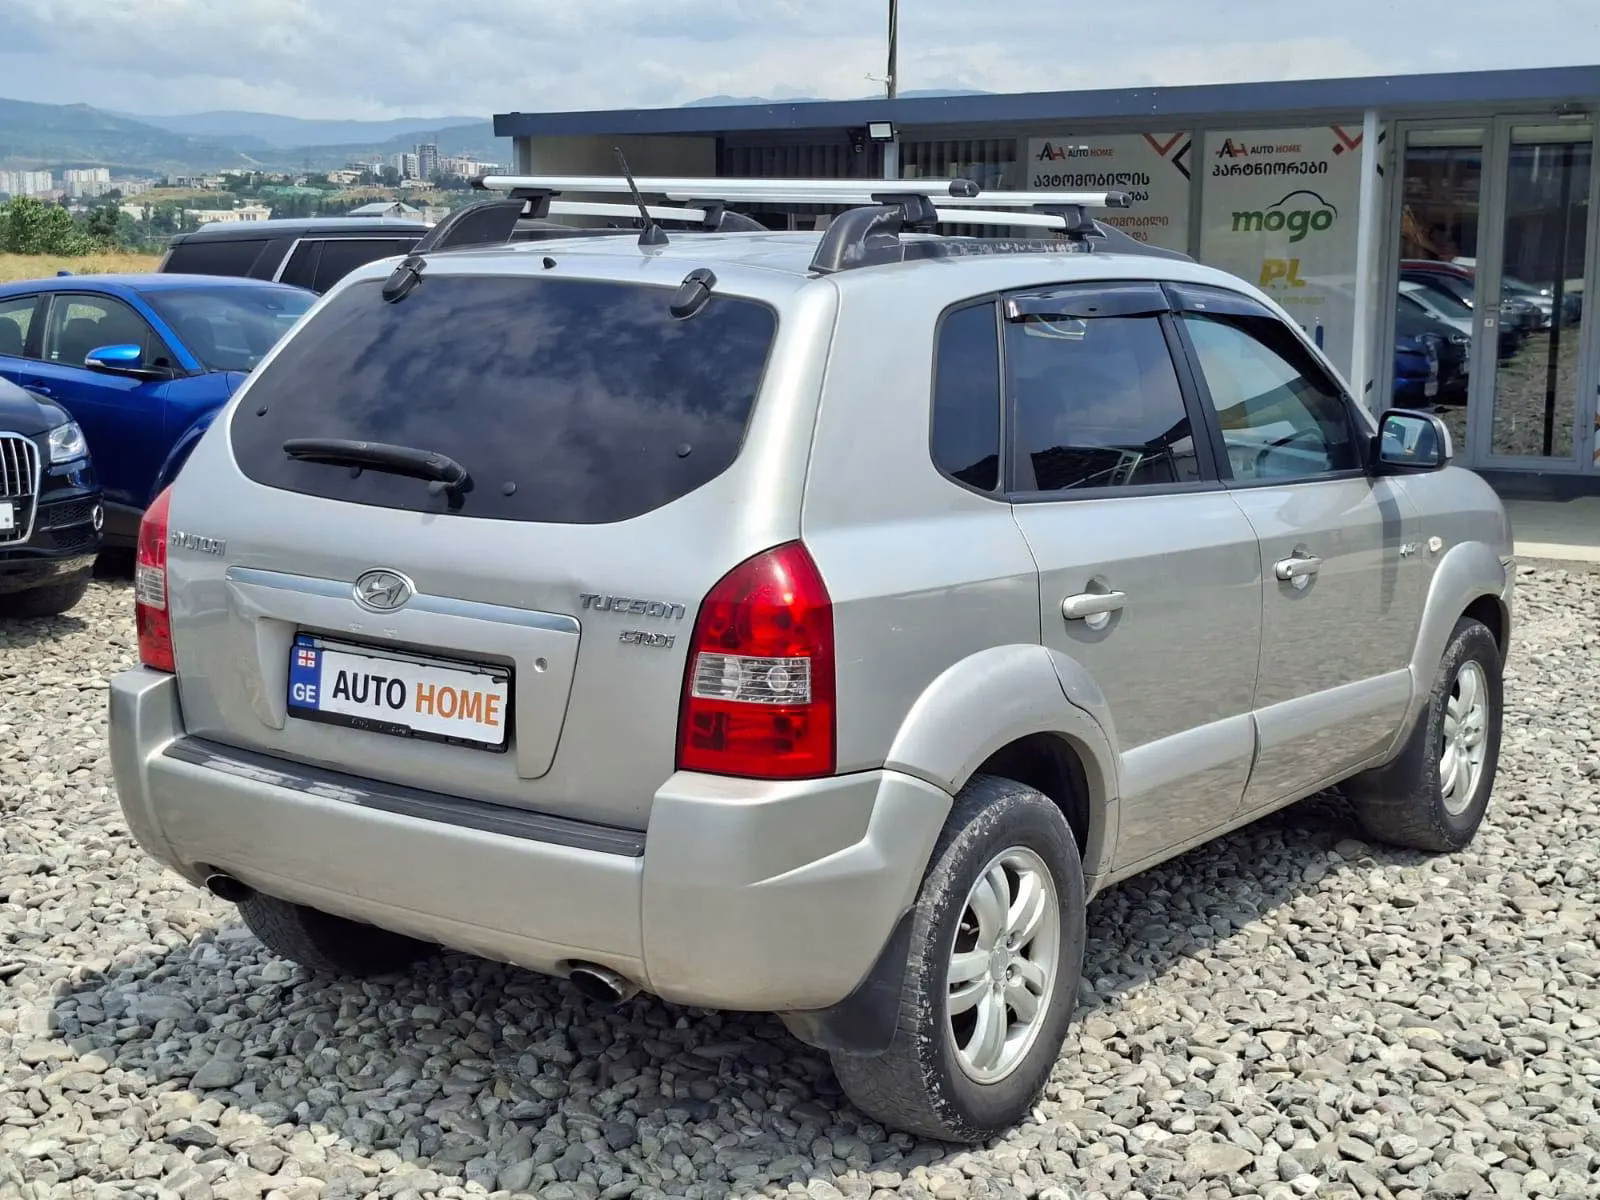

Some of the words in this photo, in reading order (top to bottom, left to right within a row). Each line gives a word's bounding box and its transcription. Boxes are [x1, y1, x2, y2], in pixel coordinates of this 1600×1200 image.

[1067, 148, 1089, 158] AUTO
[1250, 145, 1274, 154] AUTO
[1275, 144, 1301, 154] HOME
[1212, 161, 1328, 177] პარტნიორები
[1034, 172, 1150, 188] ავტომობილის
[1231, 209, 1333, 243] mogo
[579, 593, 686, 620] TUCSON
[292, 683, 316, 703] GE
[332, 670, 407, 710] AUTO
[415, 682, 501, 727] HOME
